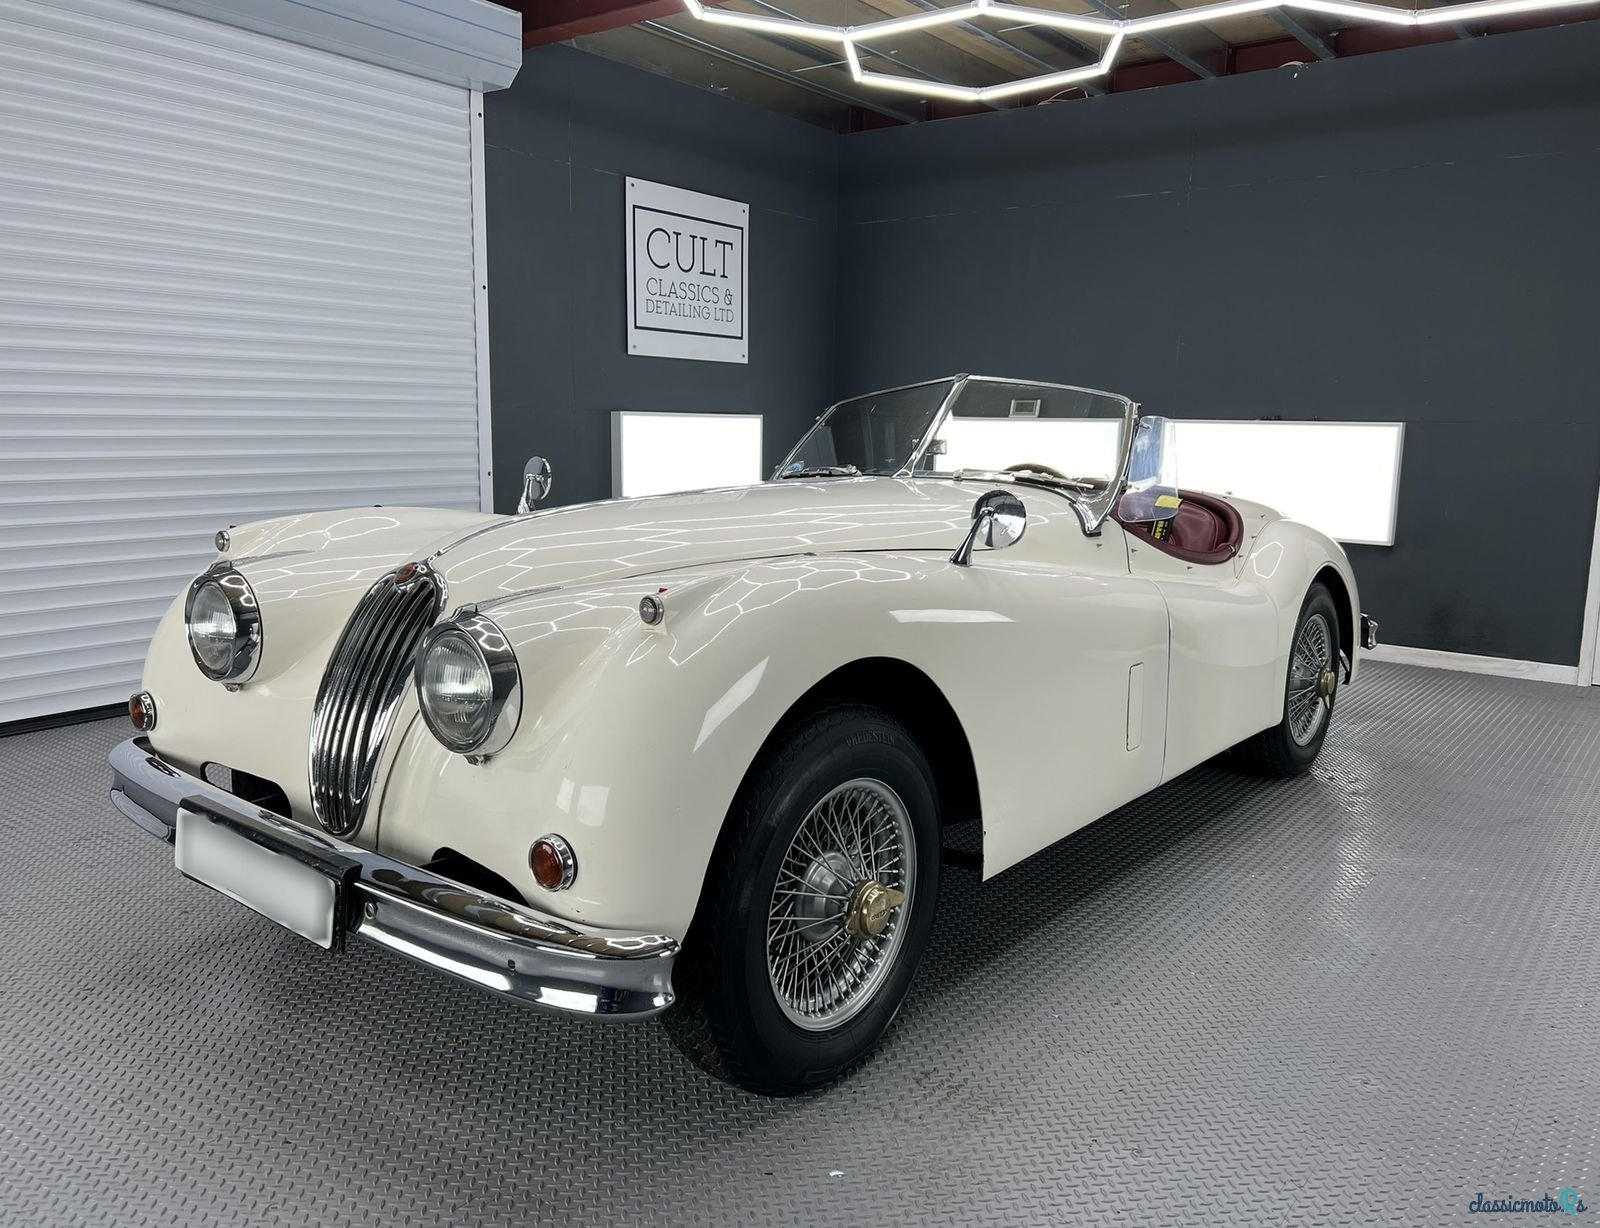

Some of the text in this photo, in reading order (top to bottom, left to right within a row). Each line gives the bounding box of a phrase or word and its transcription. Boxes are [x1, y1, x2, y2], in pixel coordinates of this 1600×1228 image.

[646, 227, 734, 279] CULT
[646, 277, 733, 306] CLASSICS &
[645, 298, 734, 323] DETAILING LTD
